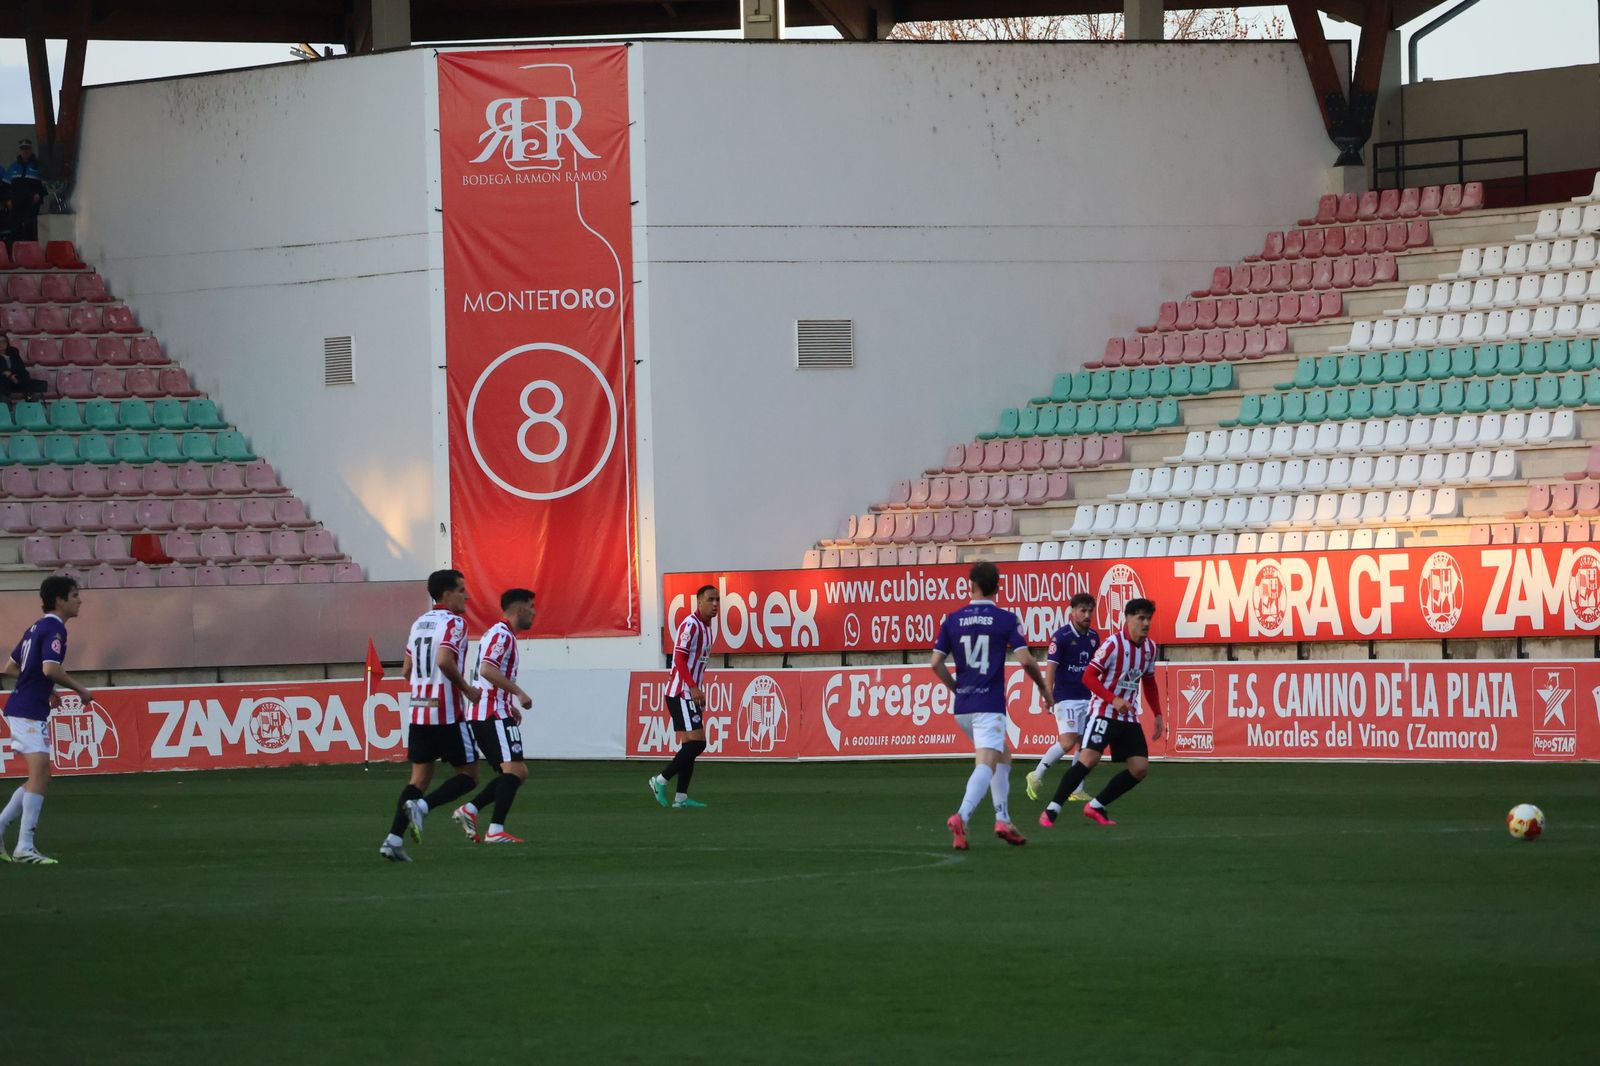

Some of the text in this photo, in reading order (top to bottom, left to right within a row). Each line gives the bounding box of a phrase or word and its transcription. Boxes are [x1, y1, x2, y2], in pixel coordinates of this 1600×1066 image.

[462, 173, 511, 186] BODEGA
[565, 170, 608, 182] RAMOS
[463, 287, 615, 313] MONTETORO
[517, 380, 567, 463] 8
[1174, 553, 1409, 638] ZAMORA CF
[871, 613, 933, 644] 675 630
[959, 616, 994, 626] TAVARES
[959, 634, 990, 675] 14
[1227, 671, 1518, 718] E.S. CAMINO DE LA PLATA
[148, 695, 362, 758] ZAMORA
[506, 725, 521, 741] 10
[1094, 718, 1108, 735] 19
[1247, 721, 1498, 751] Morales del Vino (Zamora)
[844, 733, 956, 746] A GOODLIFE FOODS COMPANY
[1023, 734, 1029, 744] A
[1176, 734, 1213, 749] RepoSTAR
[1534, 736, 1576, 752] RepoSTAR
